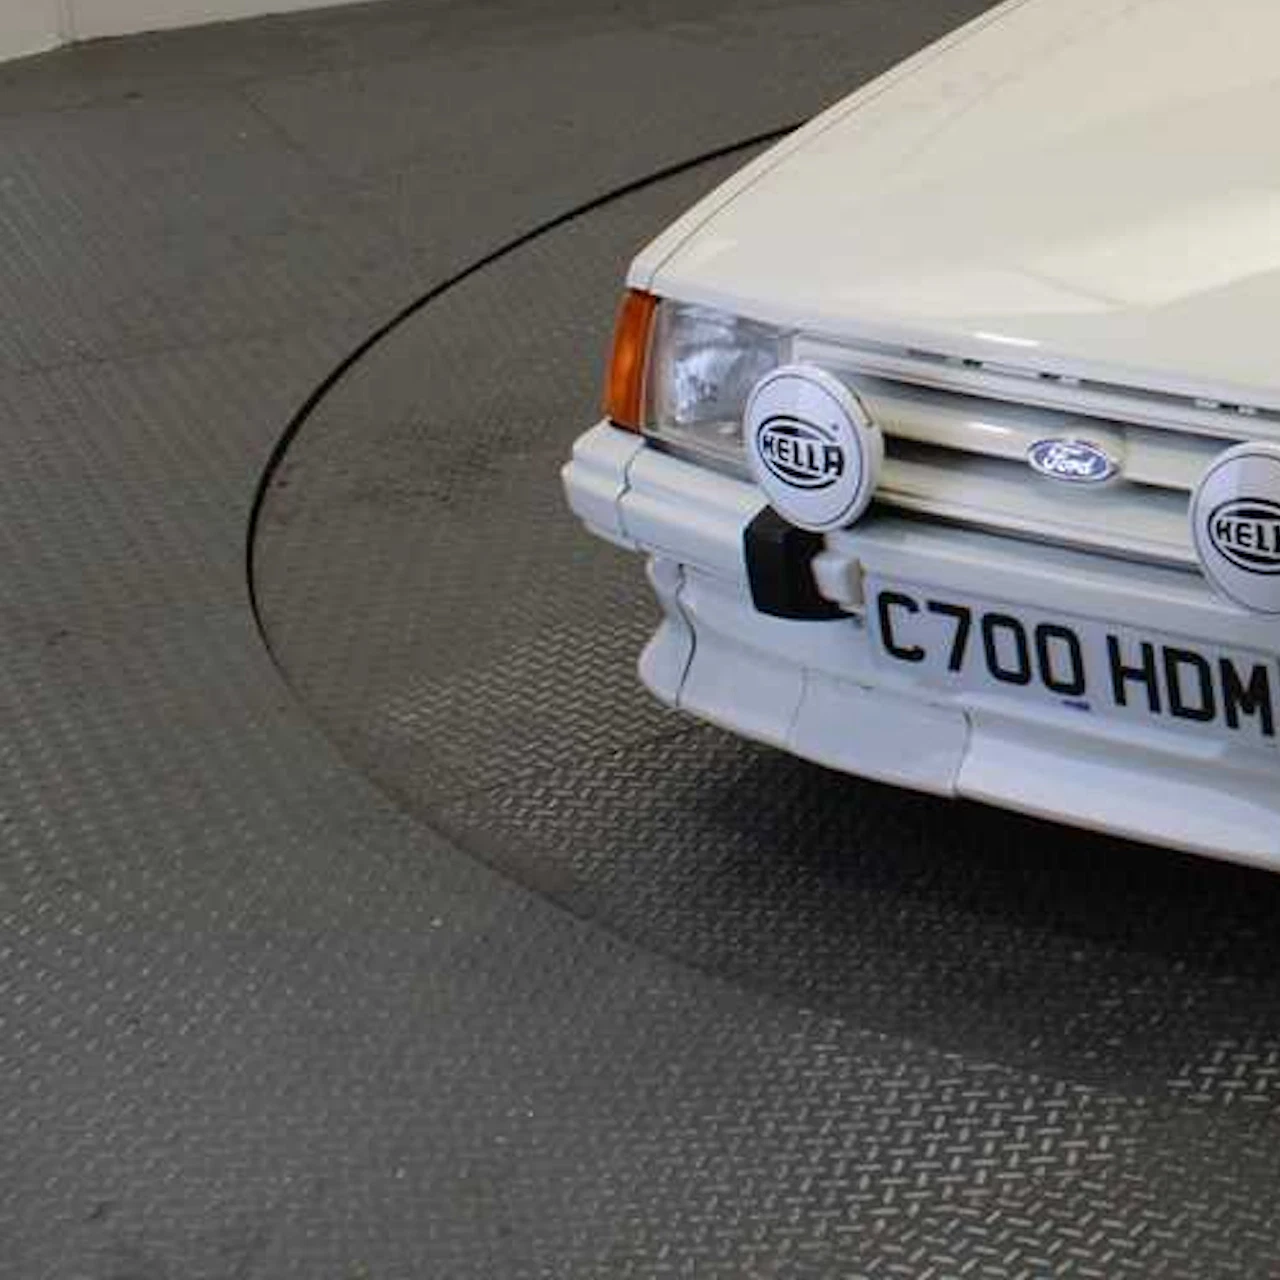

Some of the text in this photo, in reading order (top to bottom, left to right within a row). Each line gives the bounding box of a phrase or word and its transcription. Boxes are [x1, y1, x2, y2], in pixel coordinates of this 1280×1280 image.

[762, 435, 845, 477] HELLA
[1043, 442, 1098, 475] Ford
[877, 591, 1276, 737] C700 HDM
